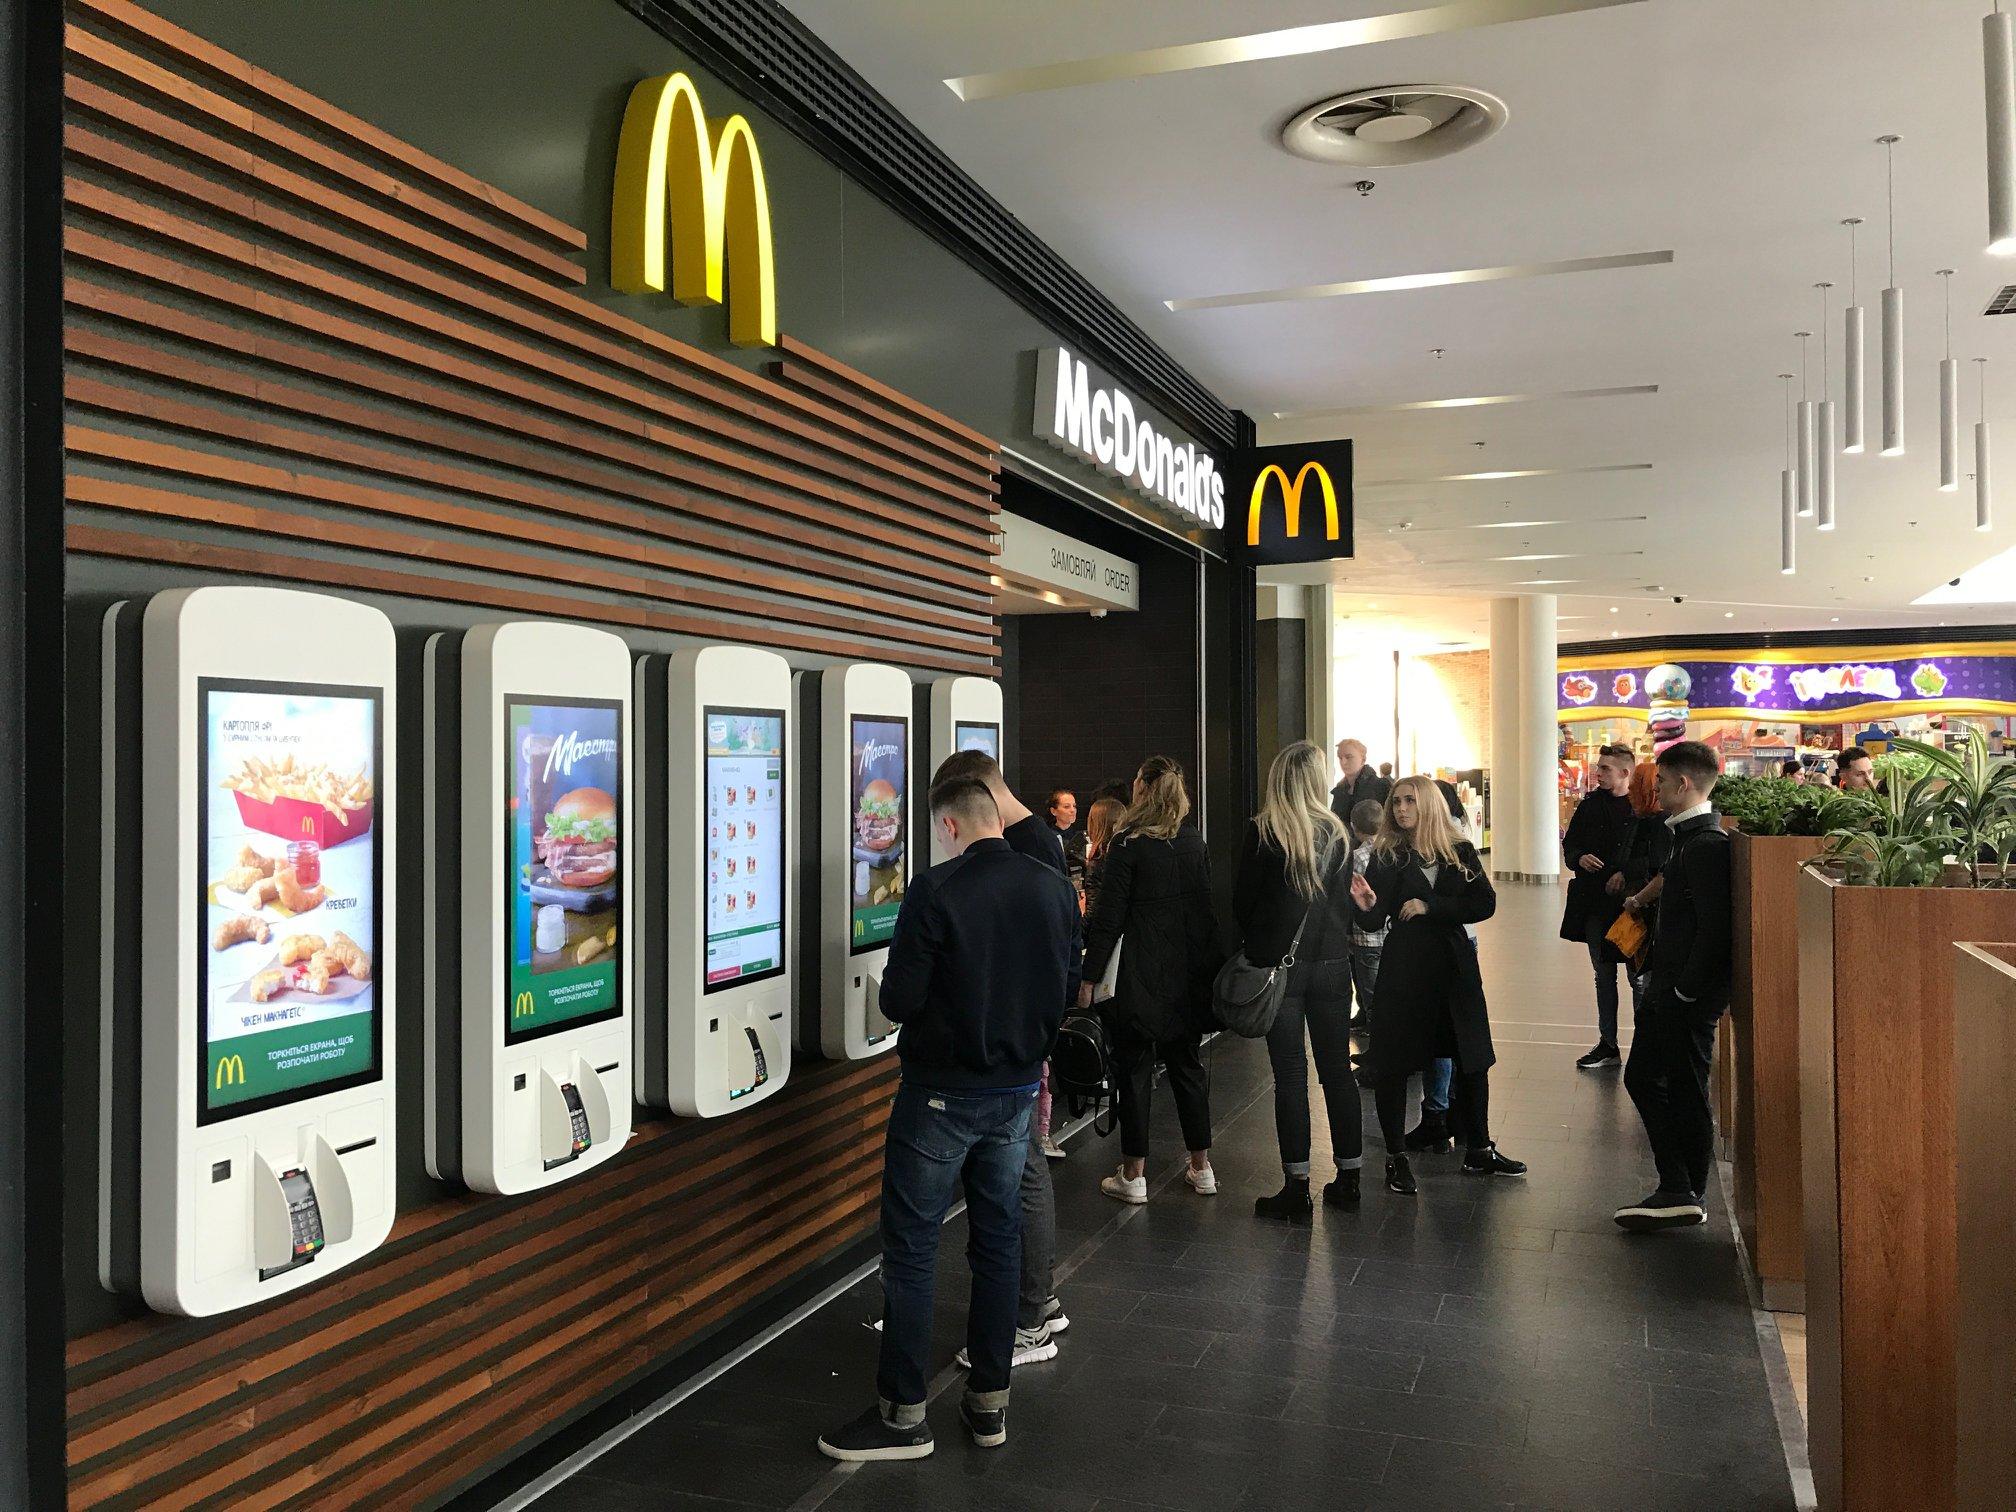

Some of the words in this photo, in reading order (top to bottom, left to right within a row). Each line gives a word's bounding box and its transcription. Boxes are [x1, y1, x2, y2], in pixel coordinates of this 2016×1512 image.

[1054, 346, 1225, 530] McDonald's
[1051, 547, 1097, 582] ЗАМОВЛЯЙ
[1104, 567, 1130, 593] ORDER
[326, 897, 357, 910] КРЕВЕТКИ
[267, 1046, 309, 1060] ТОРКНІТЬСЯ
[310, 1038, 337, 1051] ЕКРАНА,
[338, 1035, 354, 1046] ЩОБ
[277, 1054, 319, 1070] РОЗПОЧАТИ
[320, 1047, 346, 1060] РОБОТУ
